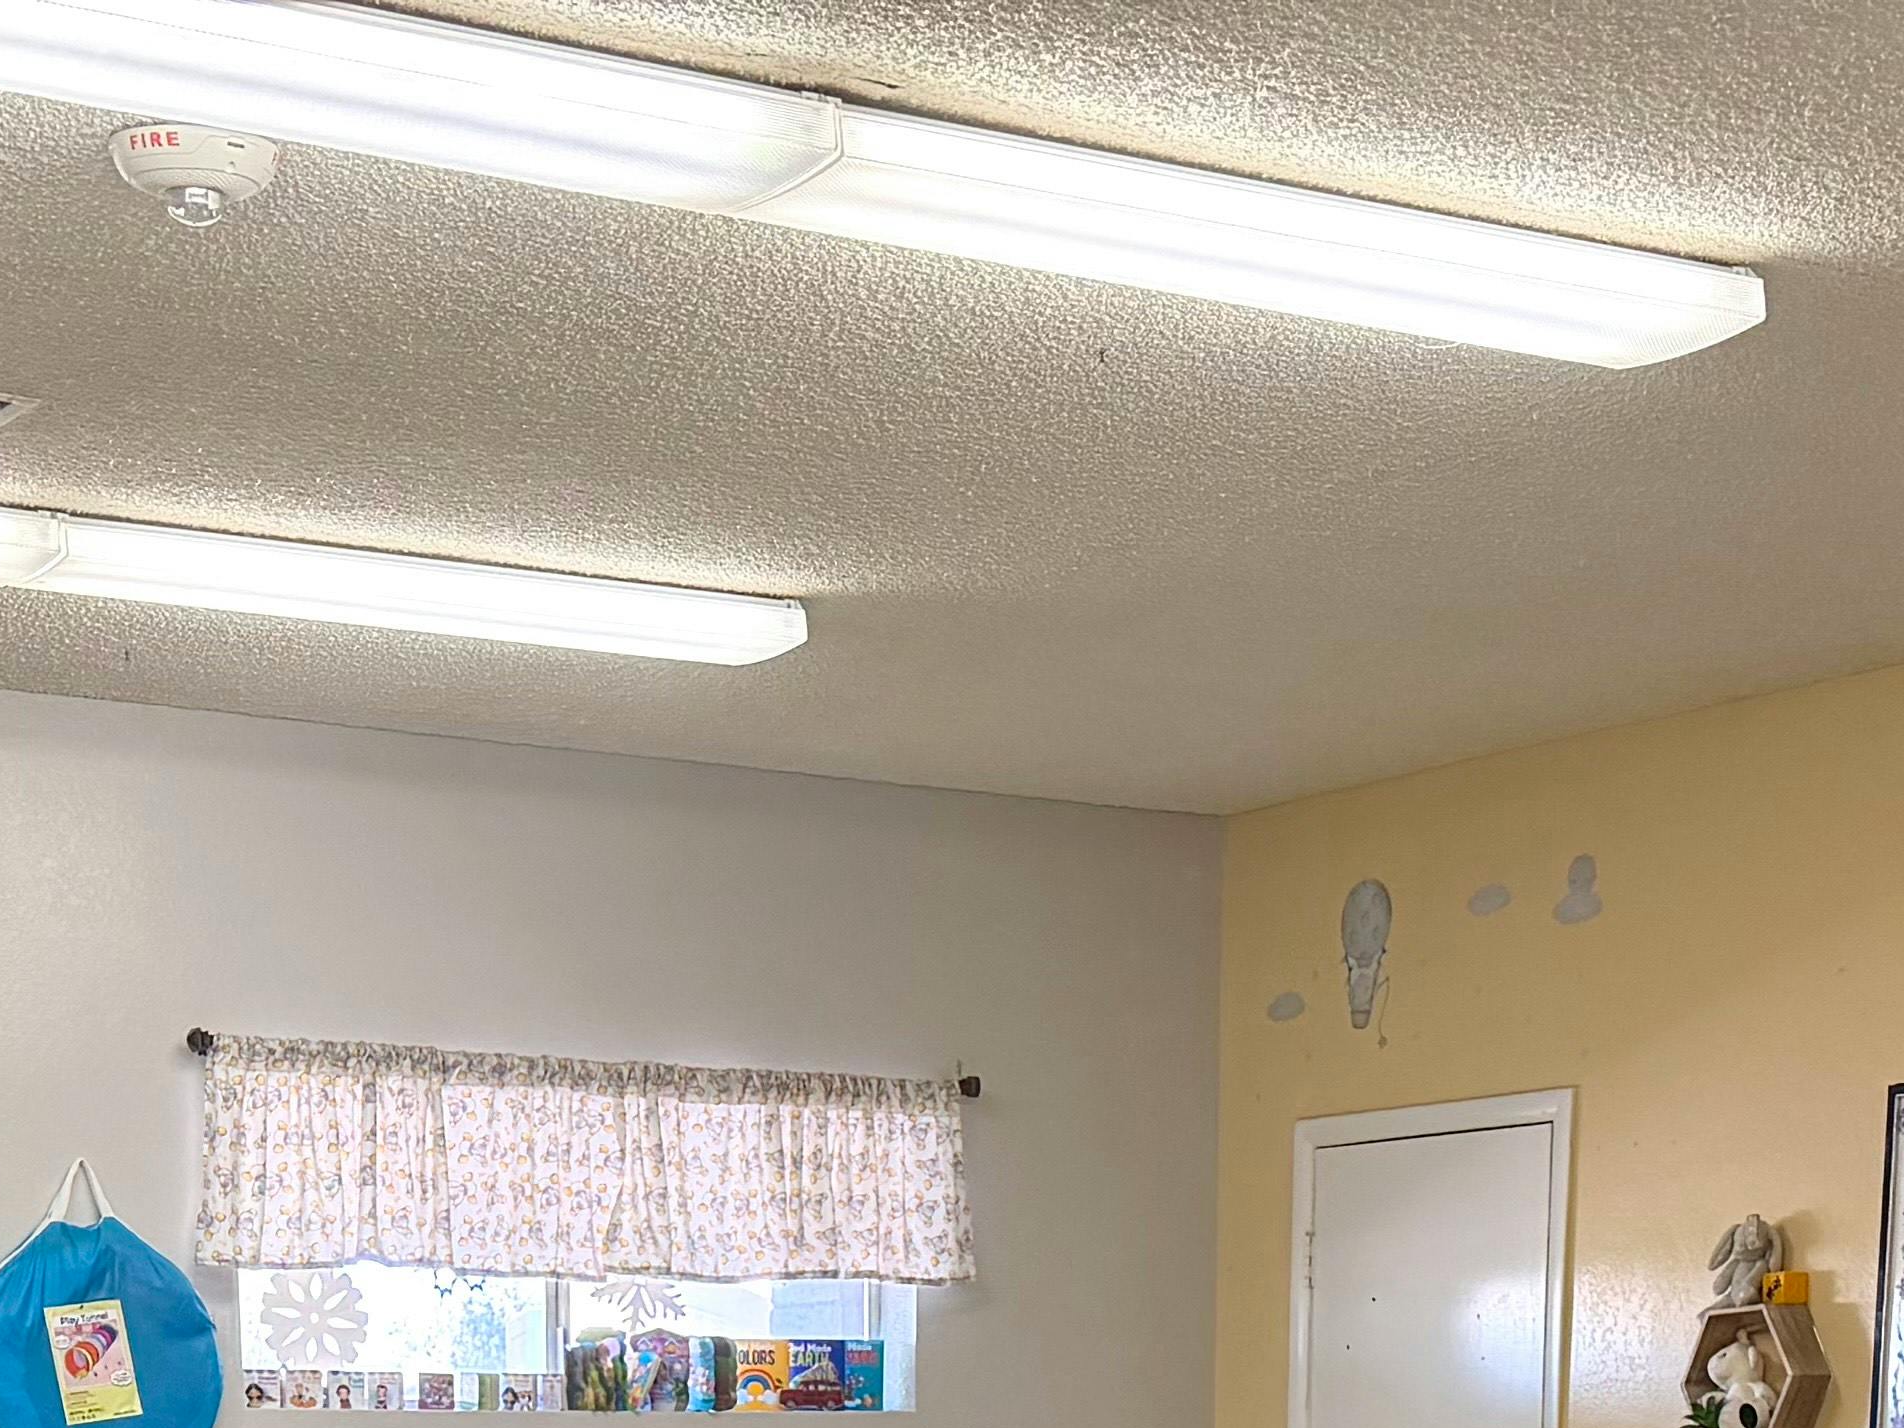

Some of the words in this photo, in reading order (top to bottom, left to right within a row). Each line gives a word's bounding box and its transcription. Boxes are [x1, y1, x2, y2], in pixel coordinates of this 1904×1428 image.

[129, 131, 180, 150] FIRE
[60, 1316, 79, 1328] Play
[738, 1348, 776, 1366] OLORS
